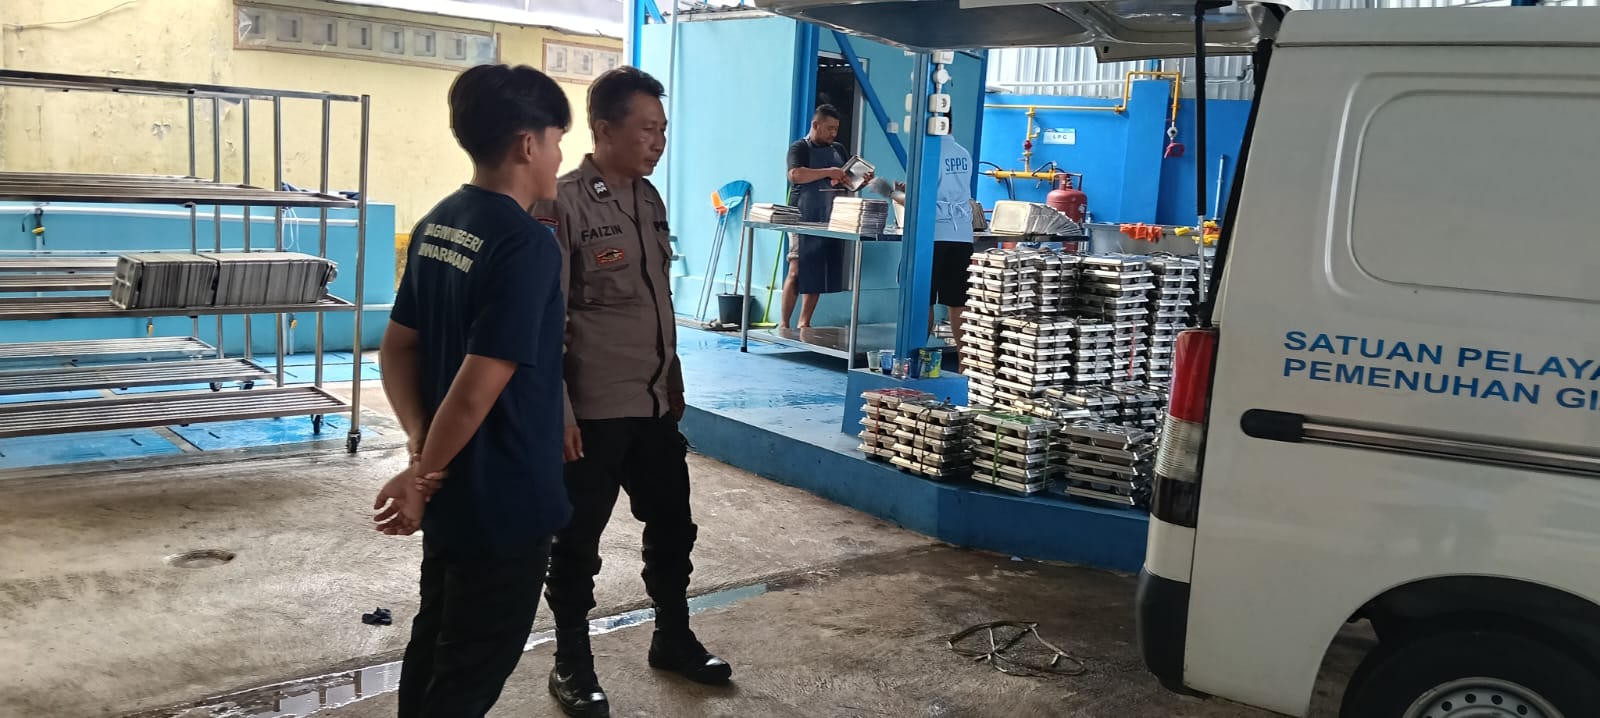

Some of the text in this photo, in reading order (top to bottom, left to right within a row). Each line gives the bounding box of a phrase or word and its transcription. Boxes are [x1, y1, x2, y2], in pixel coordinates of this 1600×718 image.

[945, 157, 968, 172] SPPG
[581, 224, 623, 242] FAIZIN
[1283, 331, 1443, 365] SATUAN
[1283, 358, 1600, 411] PEMENUHAN GI
